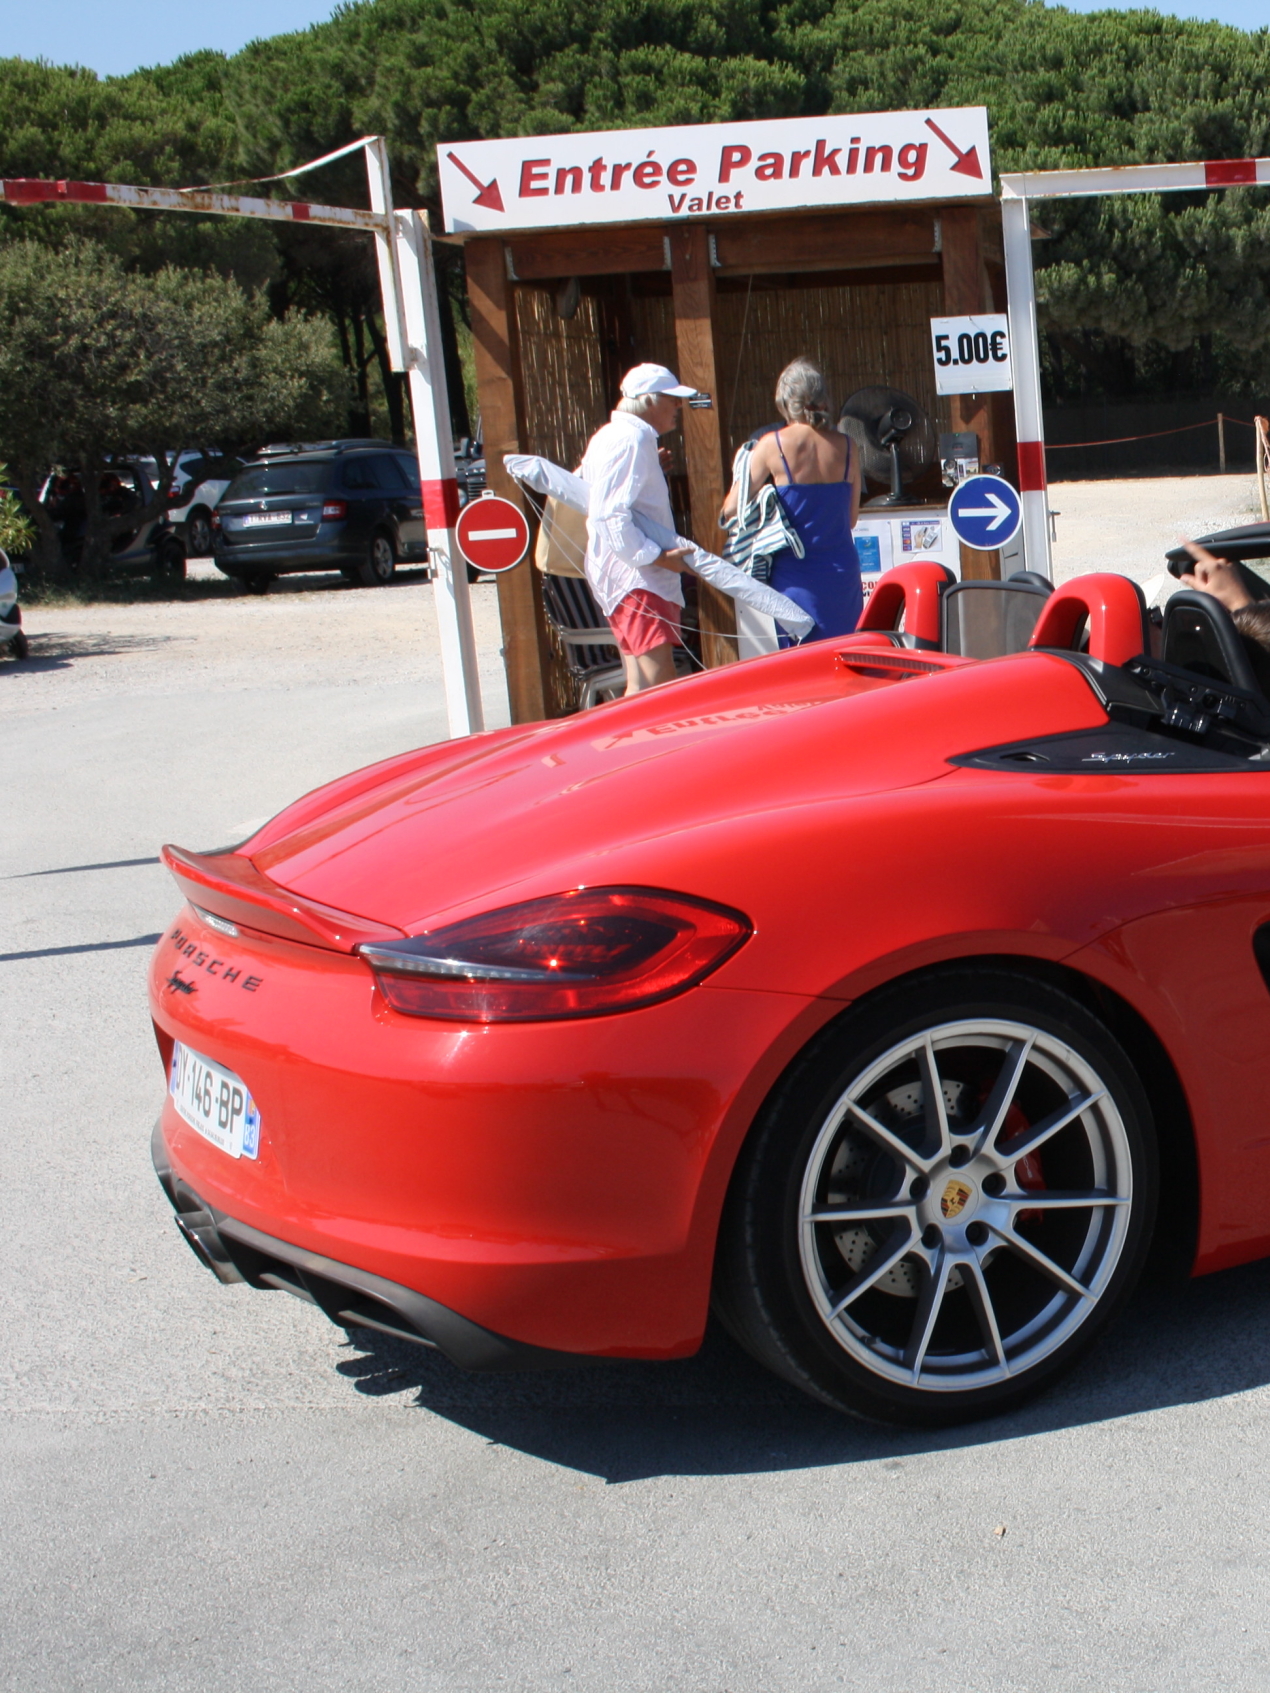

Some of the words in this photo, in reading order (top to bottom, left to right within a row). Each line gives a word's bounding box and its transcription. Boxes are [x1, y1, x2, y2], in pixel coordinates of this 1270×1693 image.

[519, 150, 698, 198] Entrée
[718, 136, 929, 184] Parking
[668, 190, 744, 214] Valet
[935, 330, 1008, 367] 5.00€
[1082, 752, 1175, 763] Spyder
[171, 928, 263, 992] PORSCHE
[244, 1123, 256, 1148] 83
